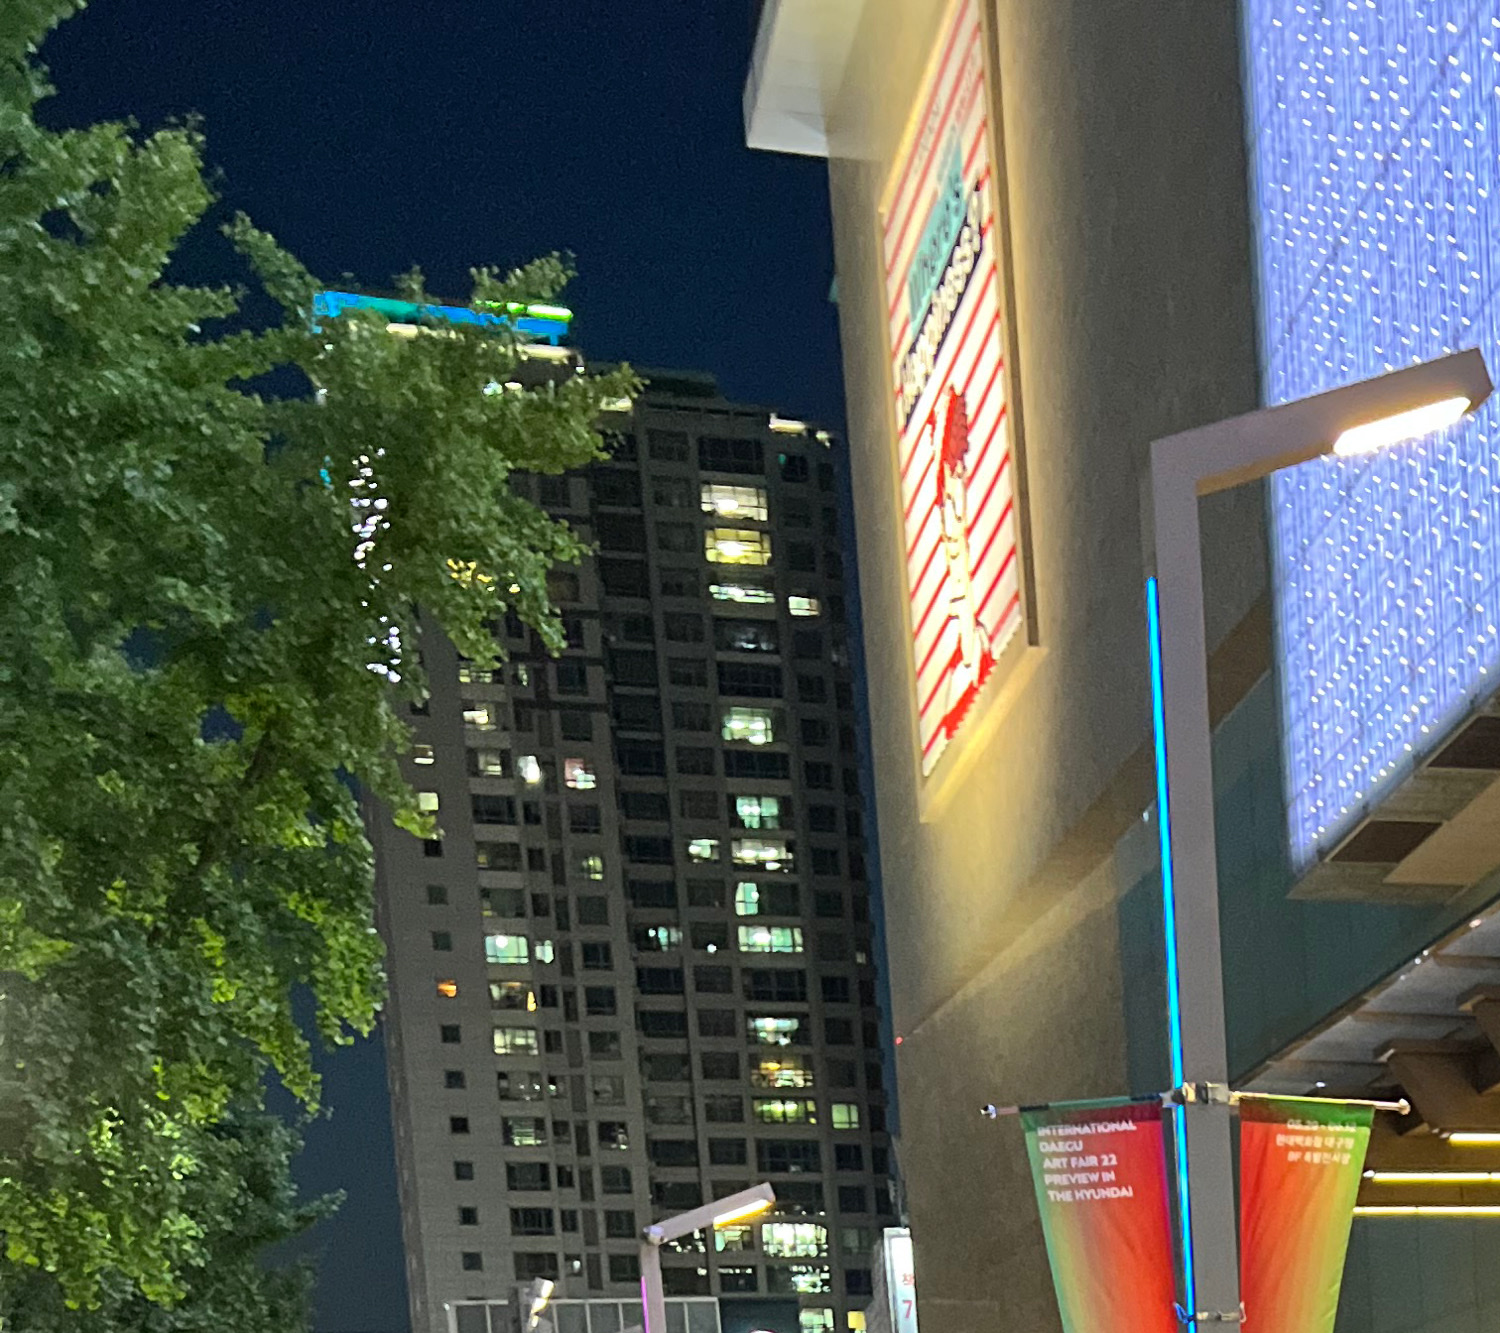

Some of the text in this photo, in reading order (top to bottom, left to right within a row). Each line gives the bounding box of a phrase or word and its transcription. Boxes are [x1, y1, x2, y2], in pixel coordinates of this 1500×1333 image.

[1037, 1120, 1137, 1136] INTERNATIONAL
[1040, 1140, 1083, 1152] DAEGU
[1043, 1154, 1118, 1169] ART FAIR 22
[1044, 1170, 1116, 1185] PREVIEW IN
[1047, 1186, 1134, 1202] THE HYUNDAI
